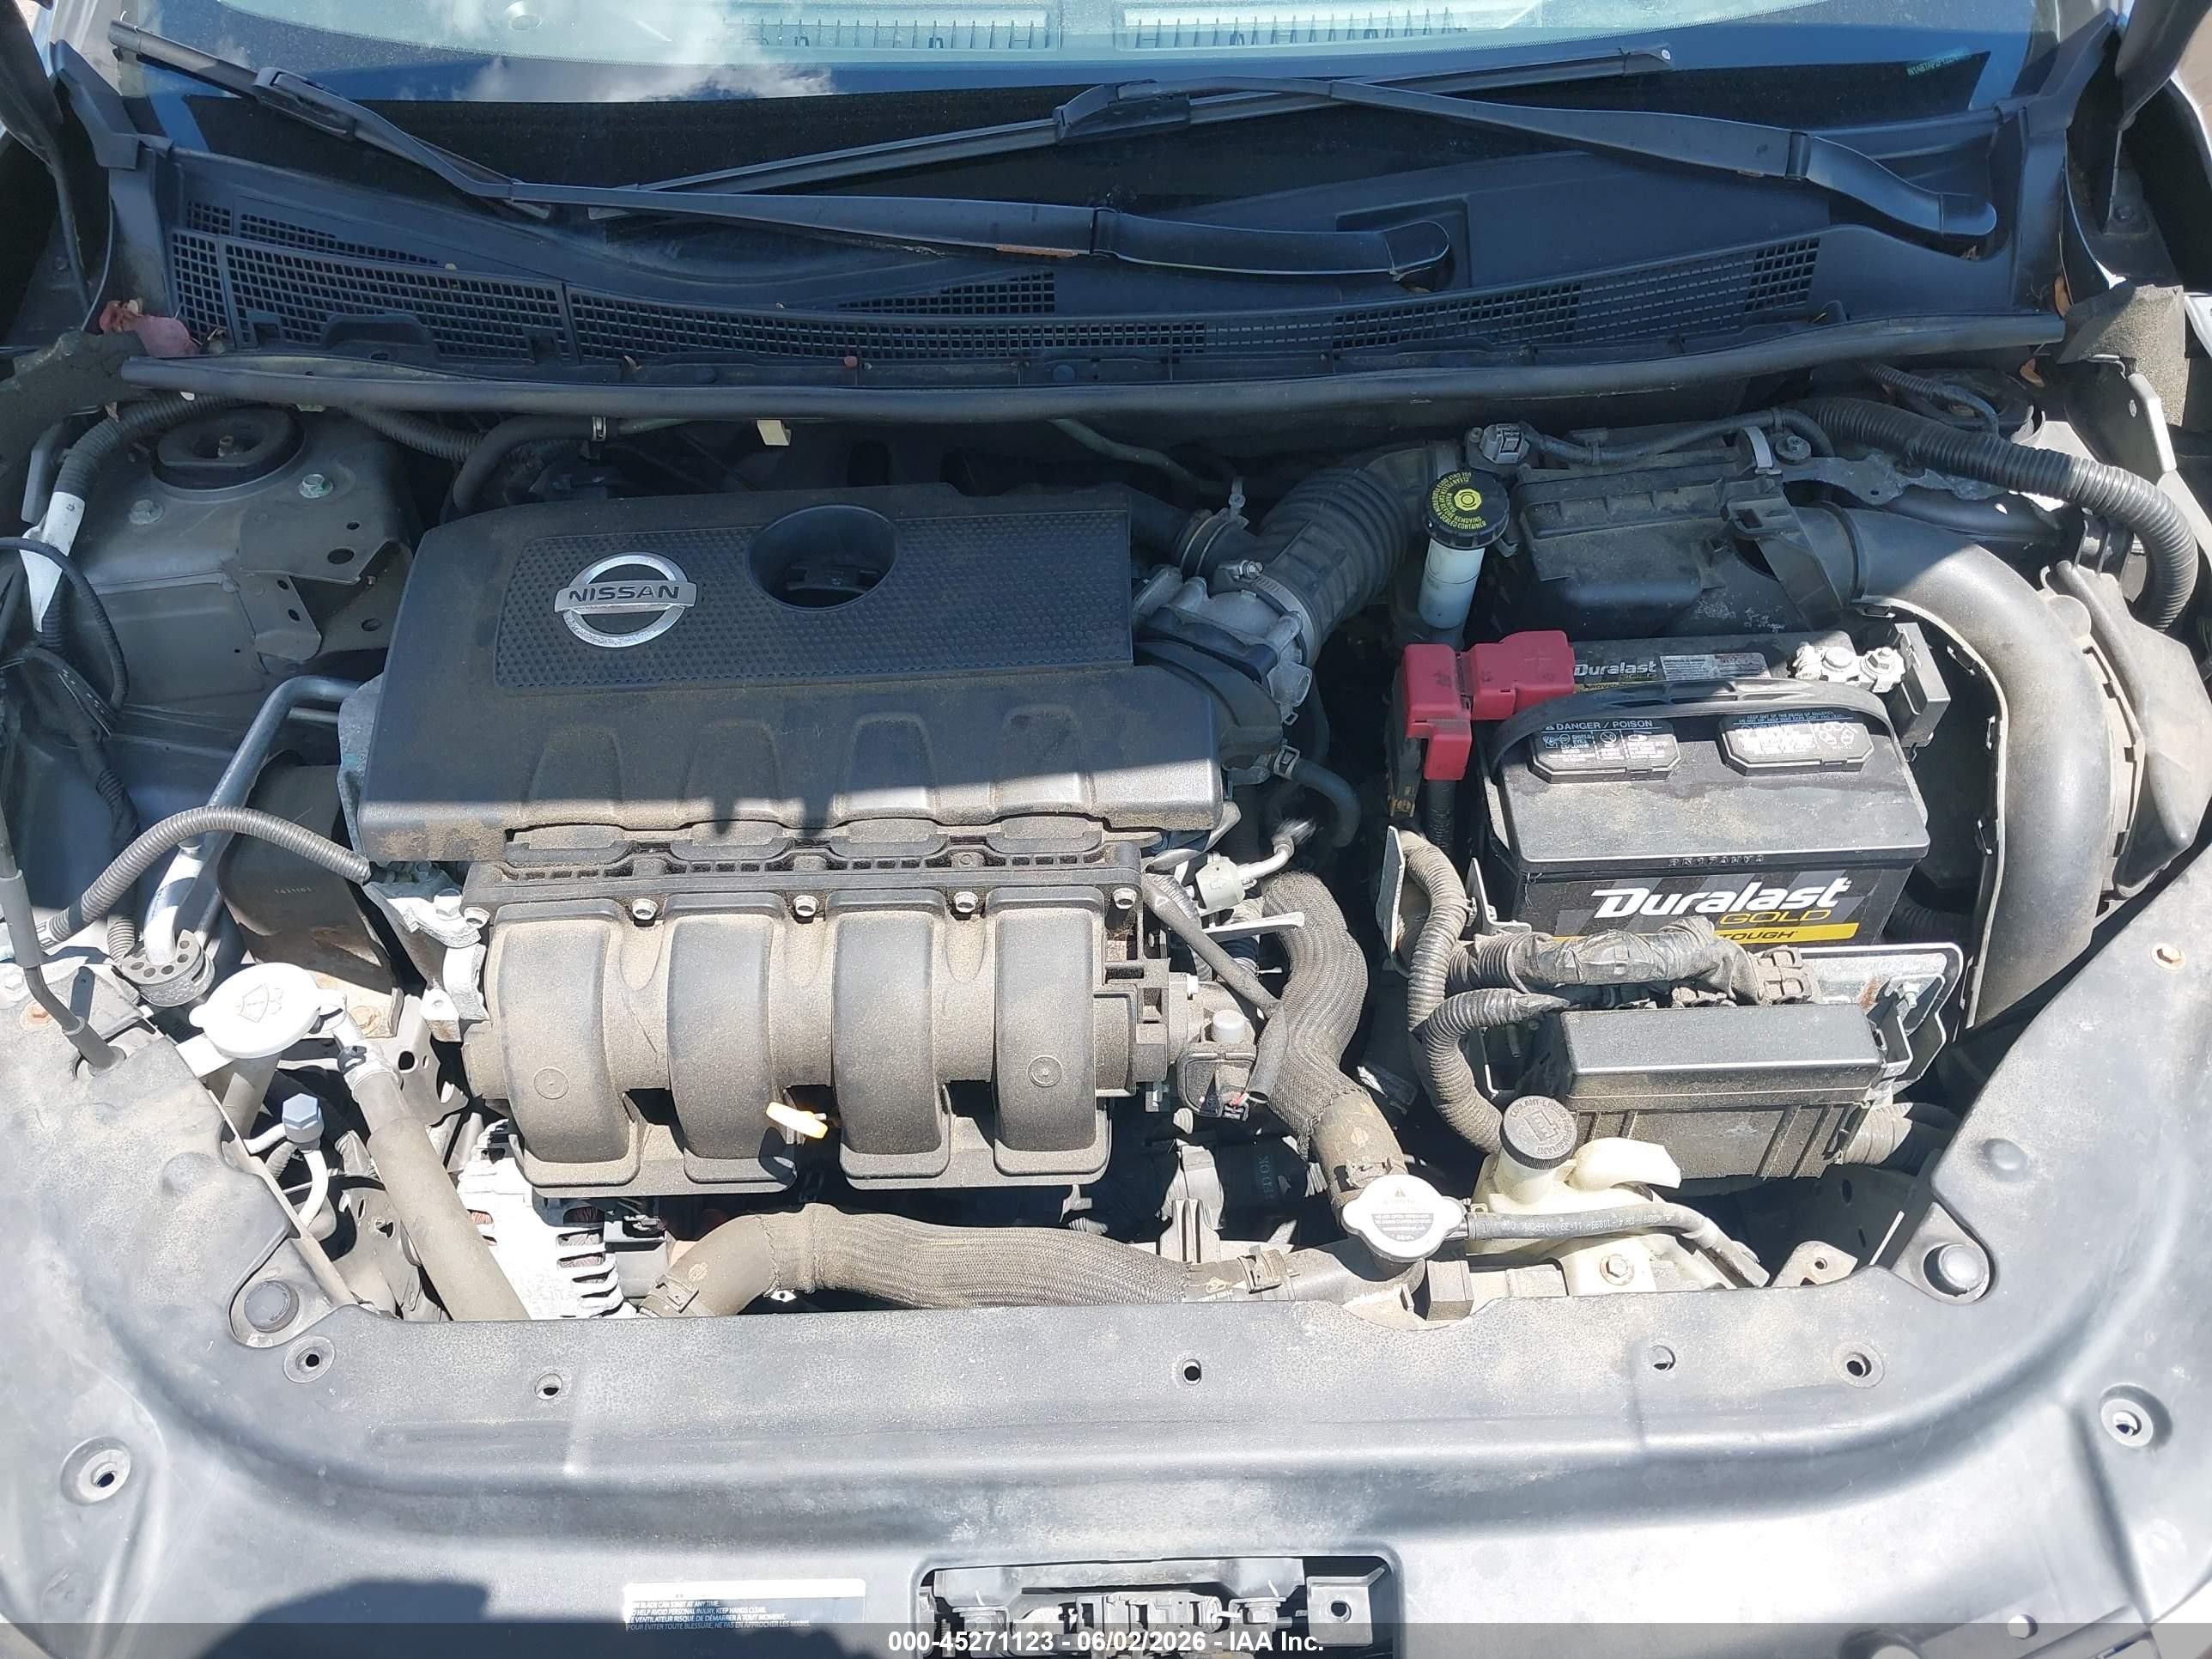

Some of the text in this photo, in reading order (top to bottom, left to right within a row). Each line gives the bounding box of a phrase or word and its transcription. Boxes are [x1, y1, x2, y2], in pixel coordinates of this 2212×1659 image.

[1440, 503, 1455, 519] BEFORE
[1440, 514, 1457, 526] SEALED
[1458, 520, 1487, 529] CONTAINER
[569, 585, 679, 602] NISSAN
[1573, 660, 1657, 676] Duralast
[1556, 722, 1601, 731] DANGER
[1612, 720, 1653, 728] POISON
[1590, 877, 1850, 919] Duralast
[1719, 909, 1831, 925] GOLD
